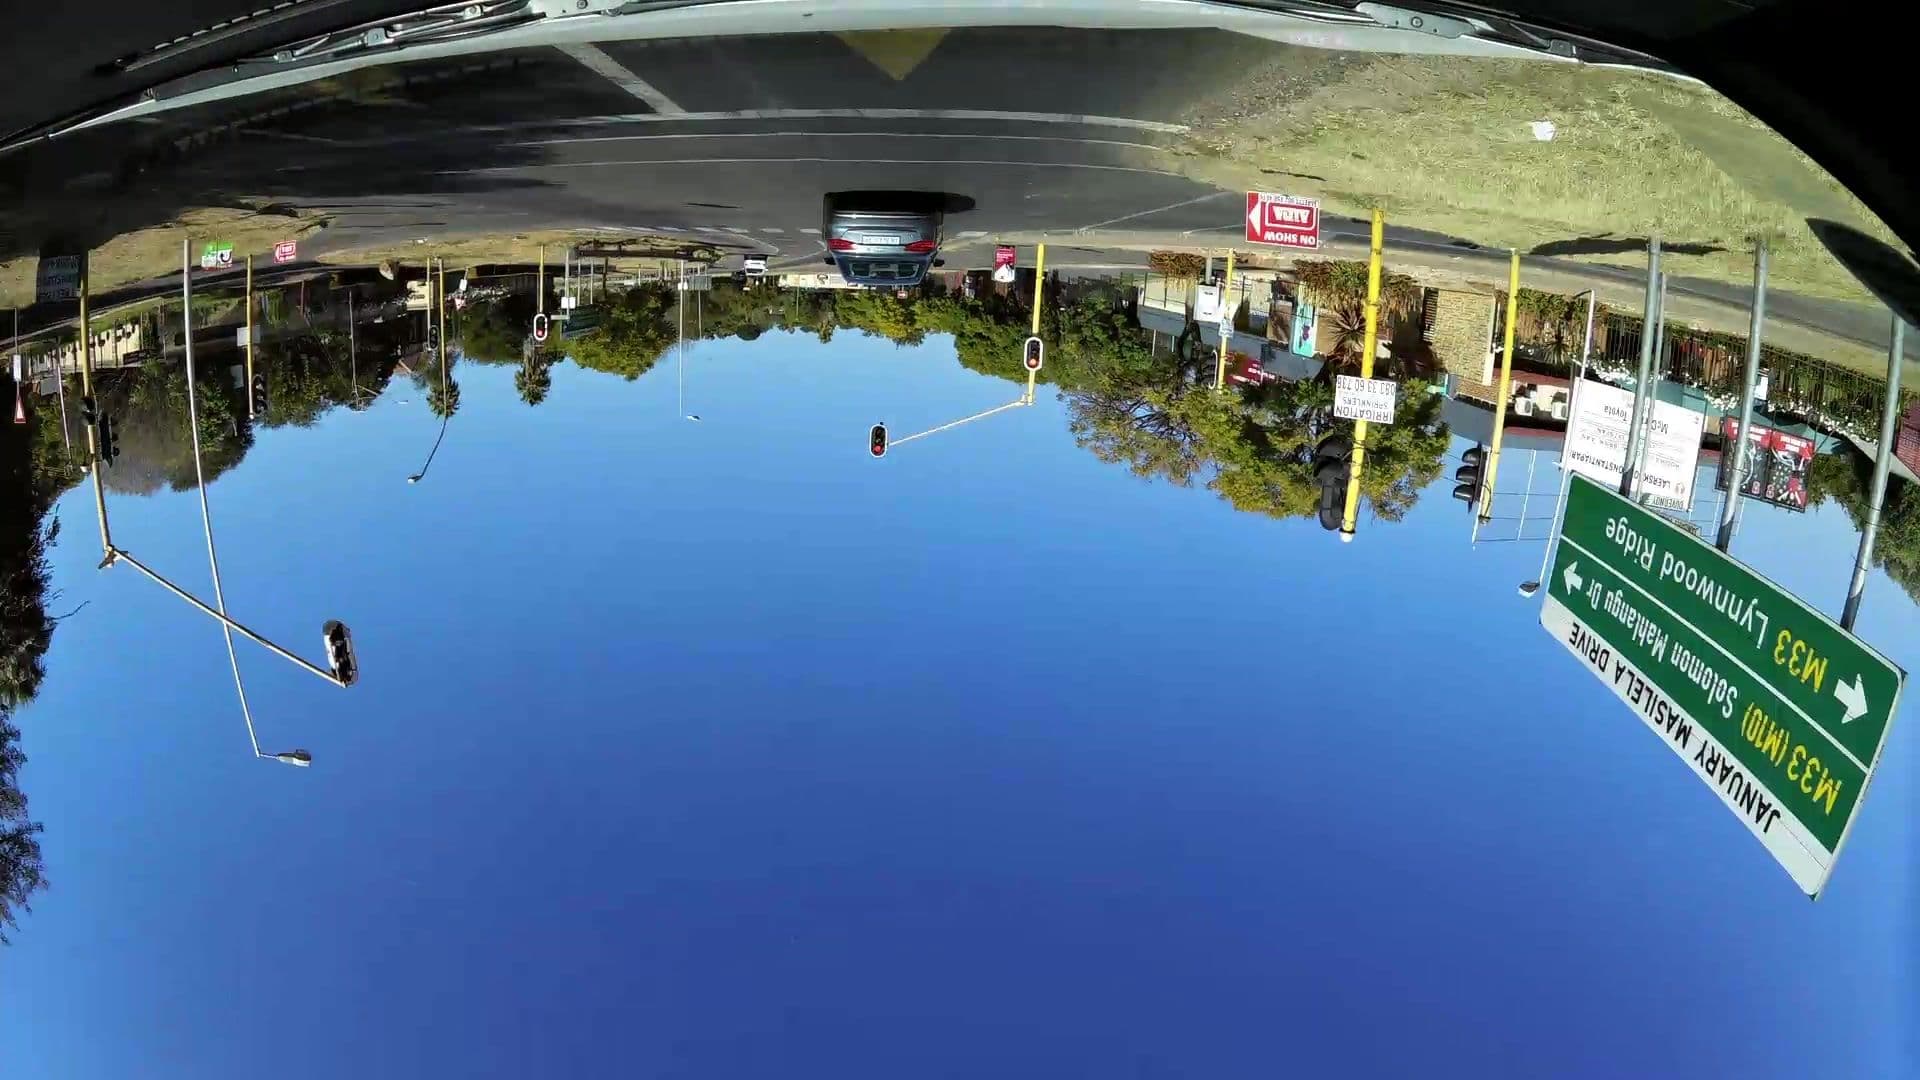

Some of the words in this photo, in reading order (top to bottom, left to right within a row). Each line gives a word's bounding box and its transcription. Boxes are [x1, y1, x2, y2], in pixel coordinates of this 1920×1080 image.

[1264, 231, 1298, 244] SHOW
[1300, 234, 1316, 245] ON
[1342, 396, 1388, 410] SPRINKLERS
[1354, 379, 1364, 392] 60
[1336, 406, 1392, 422] IRRIGATION
[1604, 406, 1628, 422] Toyota
[1568, 450, 1624, 474] ONSTANTIAPAR
[1605, 516, 1656, 574] Ridge
[1584, 579, 1601, 610] Dr
[1658, 550, 1770, 650] Lynnwood
[1568, 622, 1610, 673] DRIVE
[1603, 589, 1668, 663] Mahlangu
[1671, 642, 1738, 719] Solomon
[1774, 629, 1828, 694] M33
[1614, 659, 1692, 748] MASILELA
[1740, 702, 1789, 767] (M10)
[1694, 740, 1781, 834] JANUARY
[1786, 744, 1842, 816] M33
